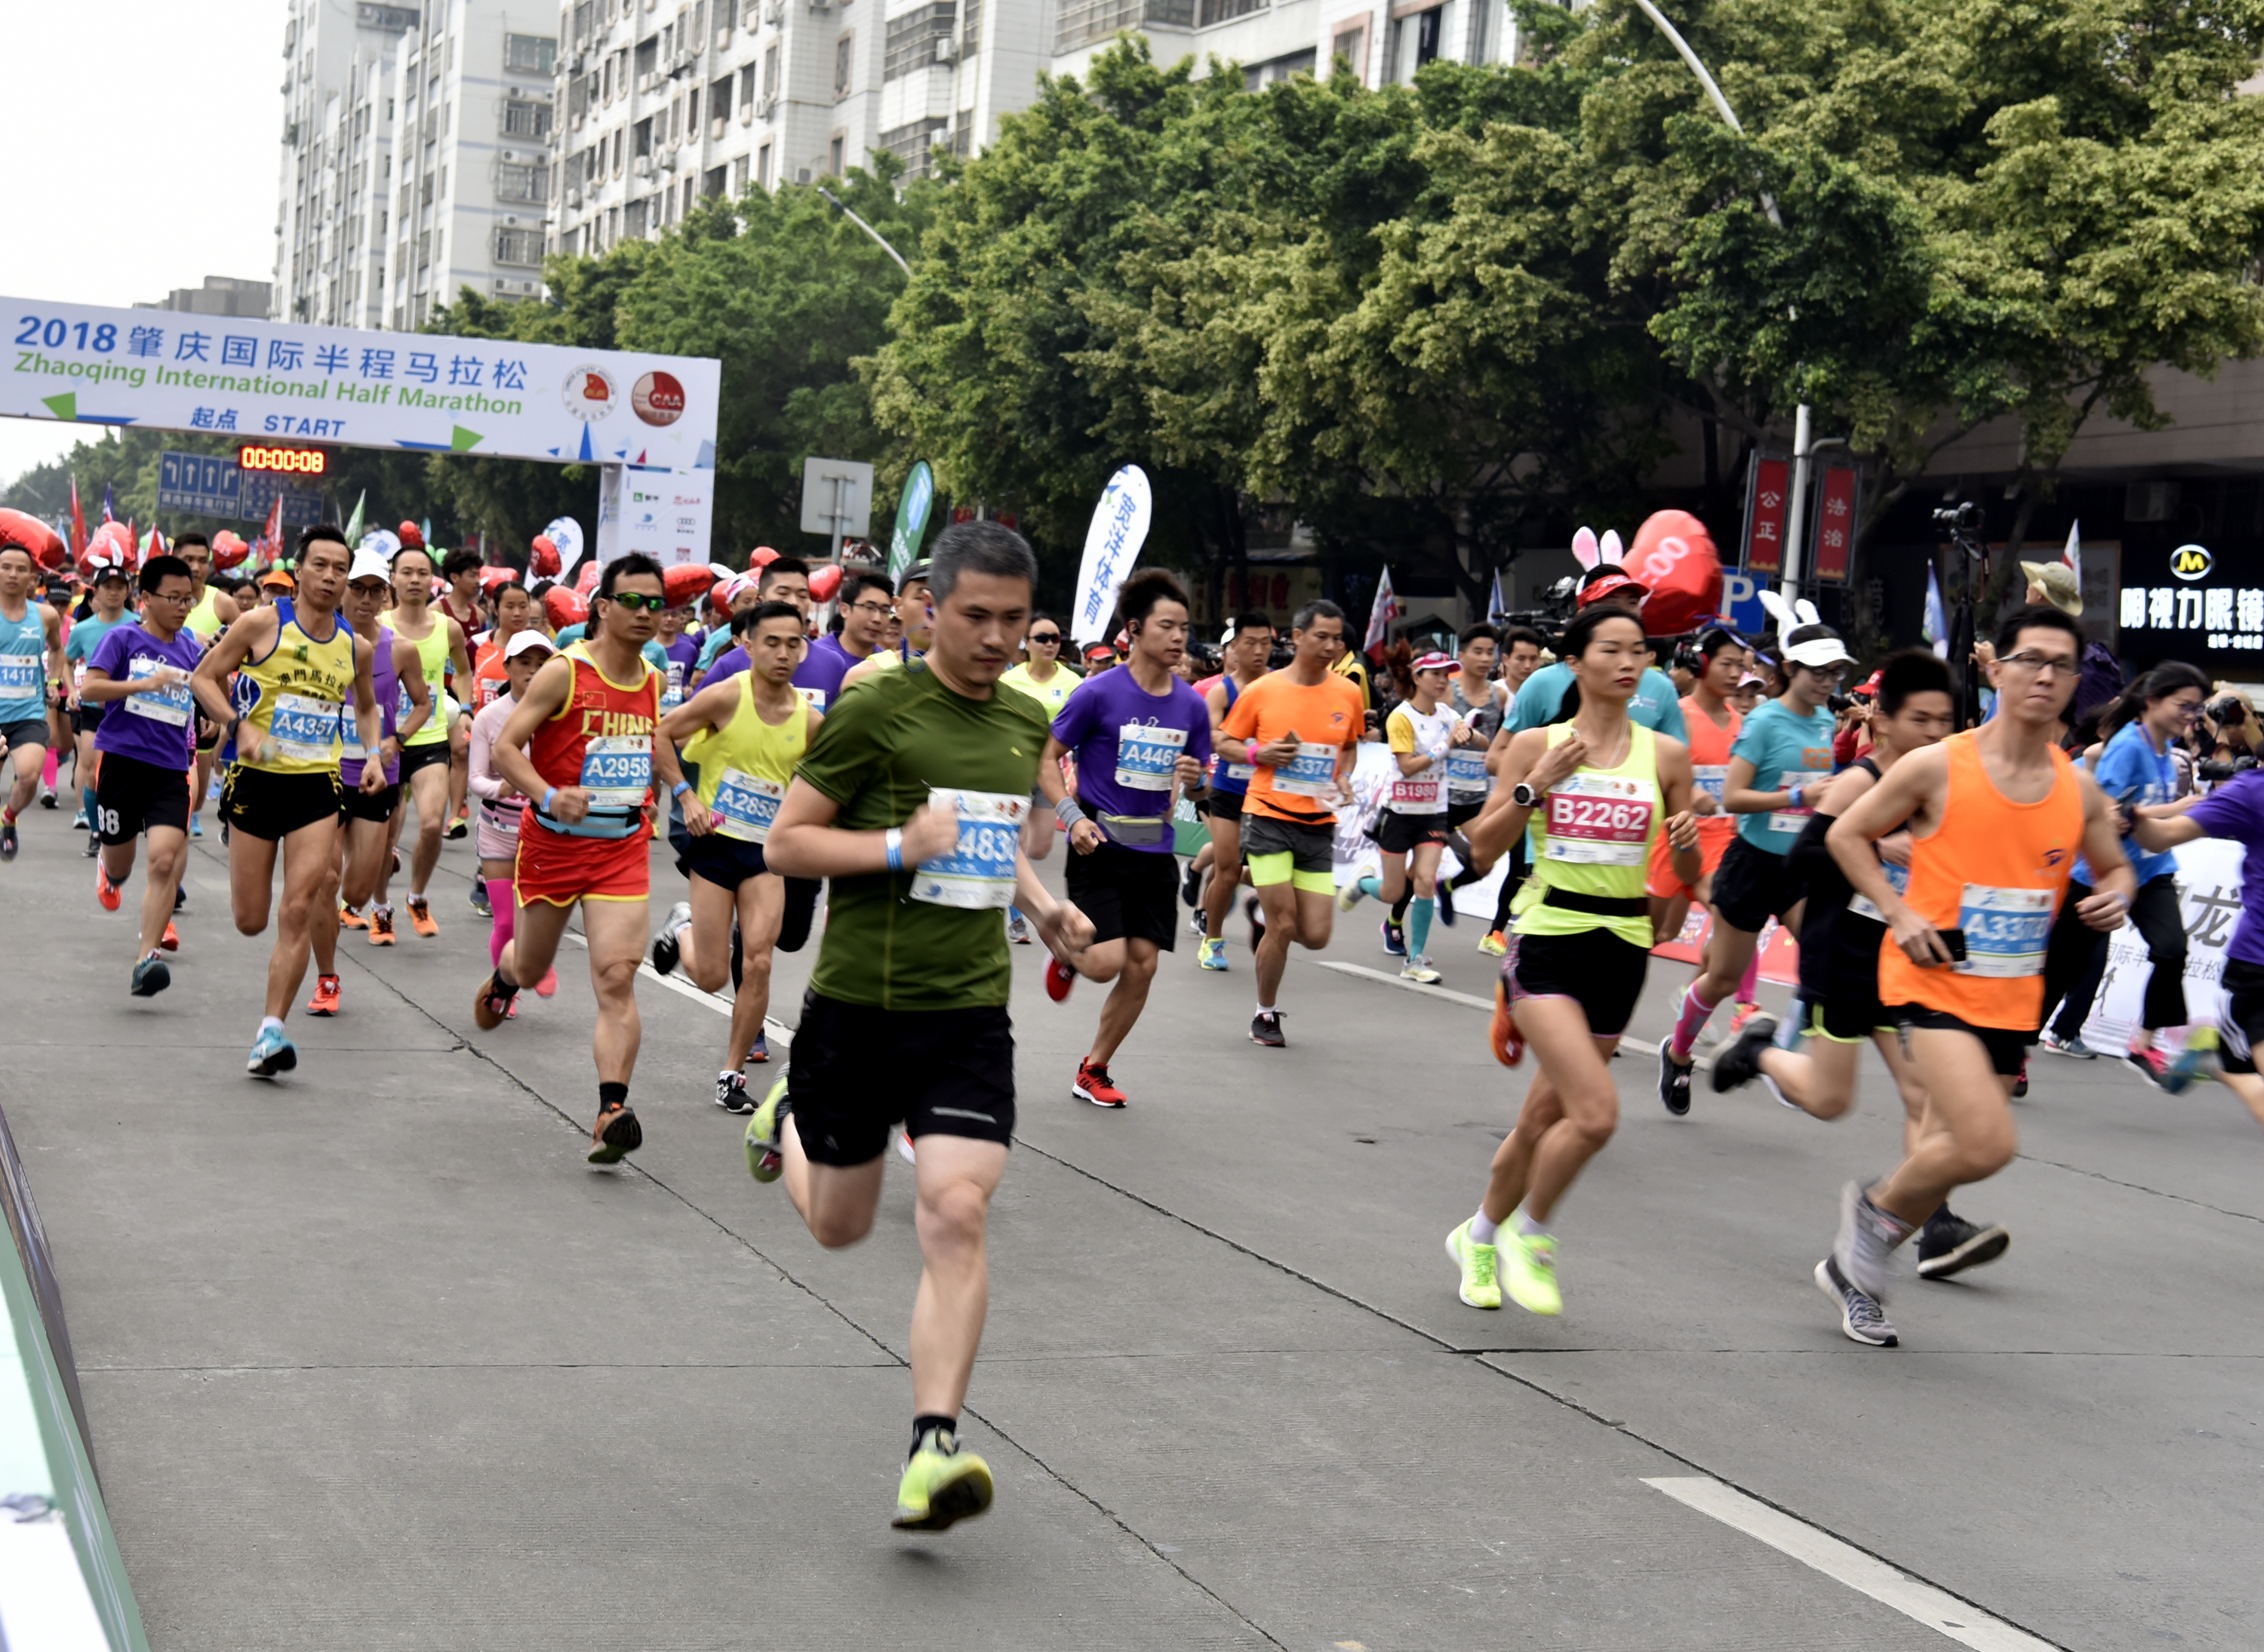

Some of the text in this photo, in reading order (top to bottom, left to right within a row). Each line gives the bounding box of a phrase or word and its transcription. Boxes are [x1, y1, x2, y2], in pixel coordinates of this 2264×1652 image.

[14, 315, 118, 353] 2018
[14, 352, 523, 416] Zhaoqing International Half Marathon
[190, 406, 346, 438] 起点 START
[241, 447, 325, 473] 00:00:08
[1755, 491, 1781, 542] 公正
[1823, 497, 1847, 548] 法治
[1721, 574, 1755, 618] P
[2120, 587, 2264, 632] 明视力眼镜
[0, 667, 35, 681] 1411
[275, 712, 337, 736] A4357
[585, 756, 651, 778] A2958
[1124, 744, 1181, 767] A446
[1286, 758, 1333, 776] 3374
[97, 804, 120, 835] 88
[718, 787, 779, 820] A2858
[1552, 798, 1649, 830] B2262
[949, 826, 1017, 863] 483
